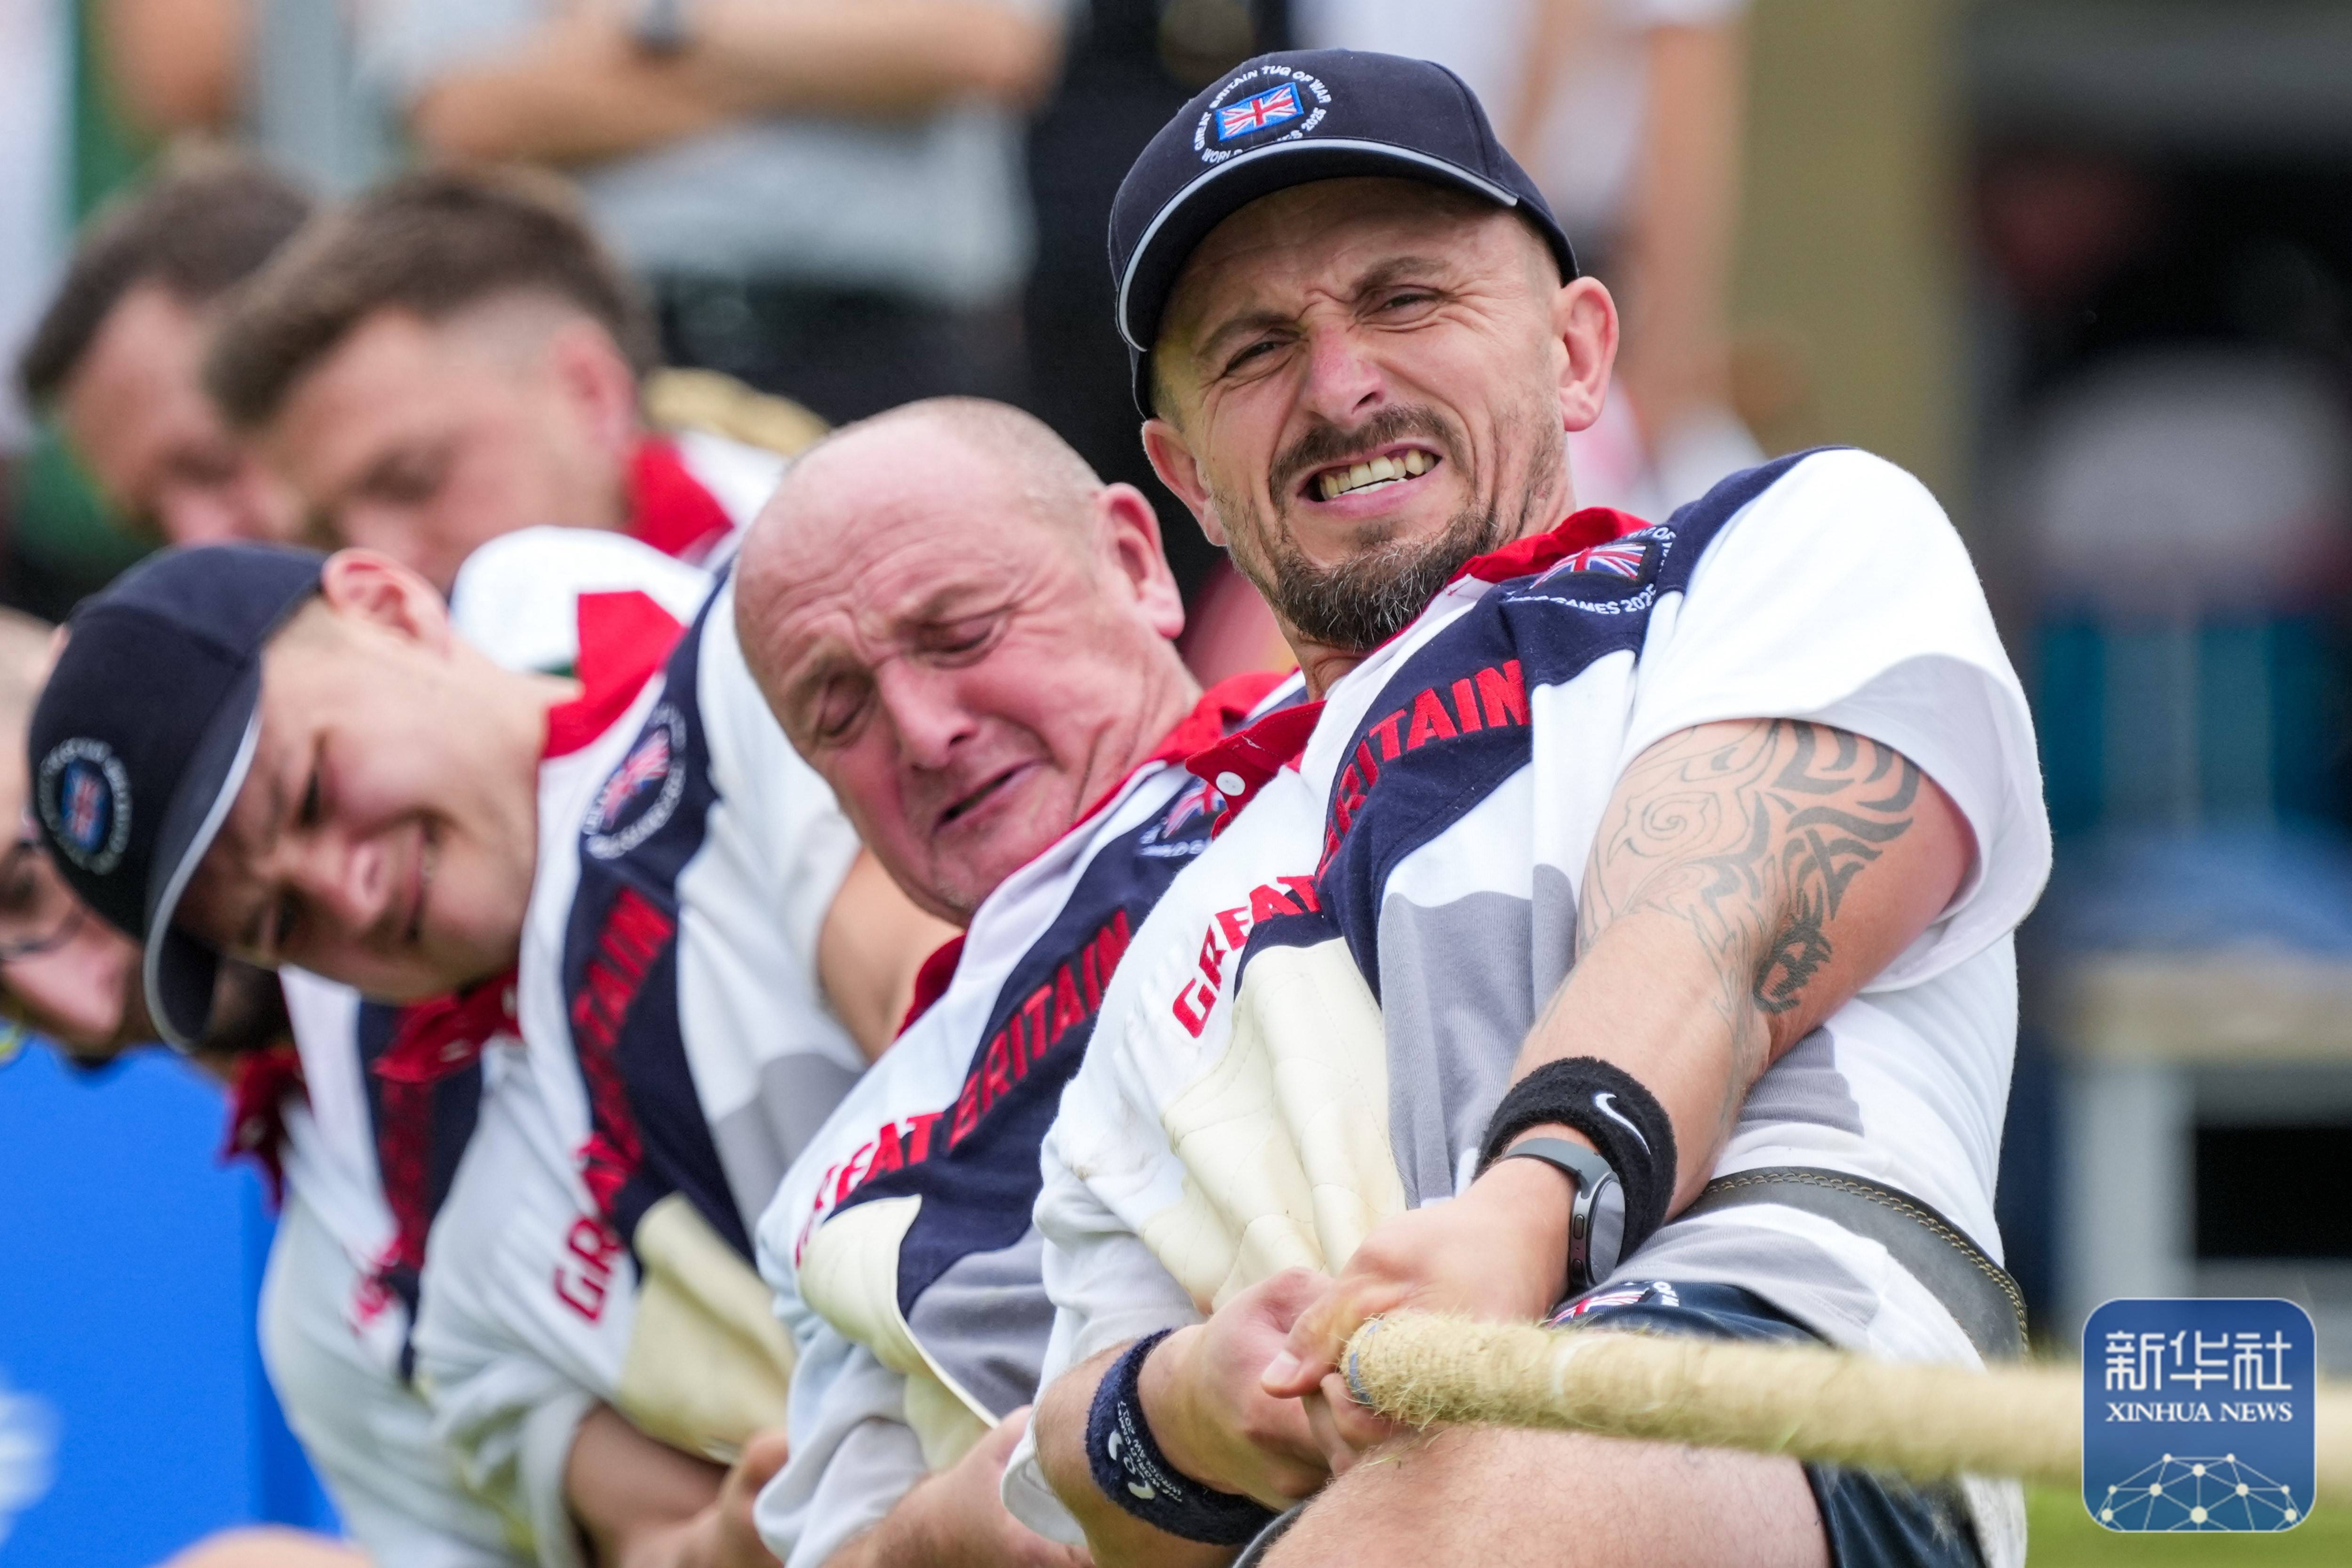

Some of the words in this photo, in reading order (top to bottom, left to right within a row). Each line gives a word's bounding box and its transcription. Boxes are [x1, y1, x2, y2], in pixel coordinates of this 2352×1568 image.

[1209, 70, 1258, 109] BRITAIN
[1261, 65, 1292, 77] TUG
[1292, 71, 1314, 82] OF
[1309, 79, 1332, 103] WAR
[947, 908, 1129, 1151] BRITAIN
[1173, 875, 1320, 1038] GREAT
